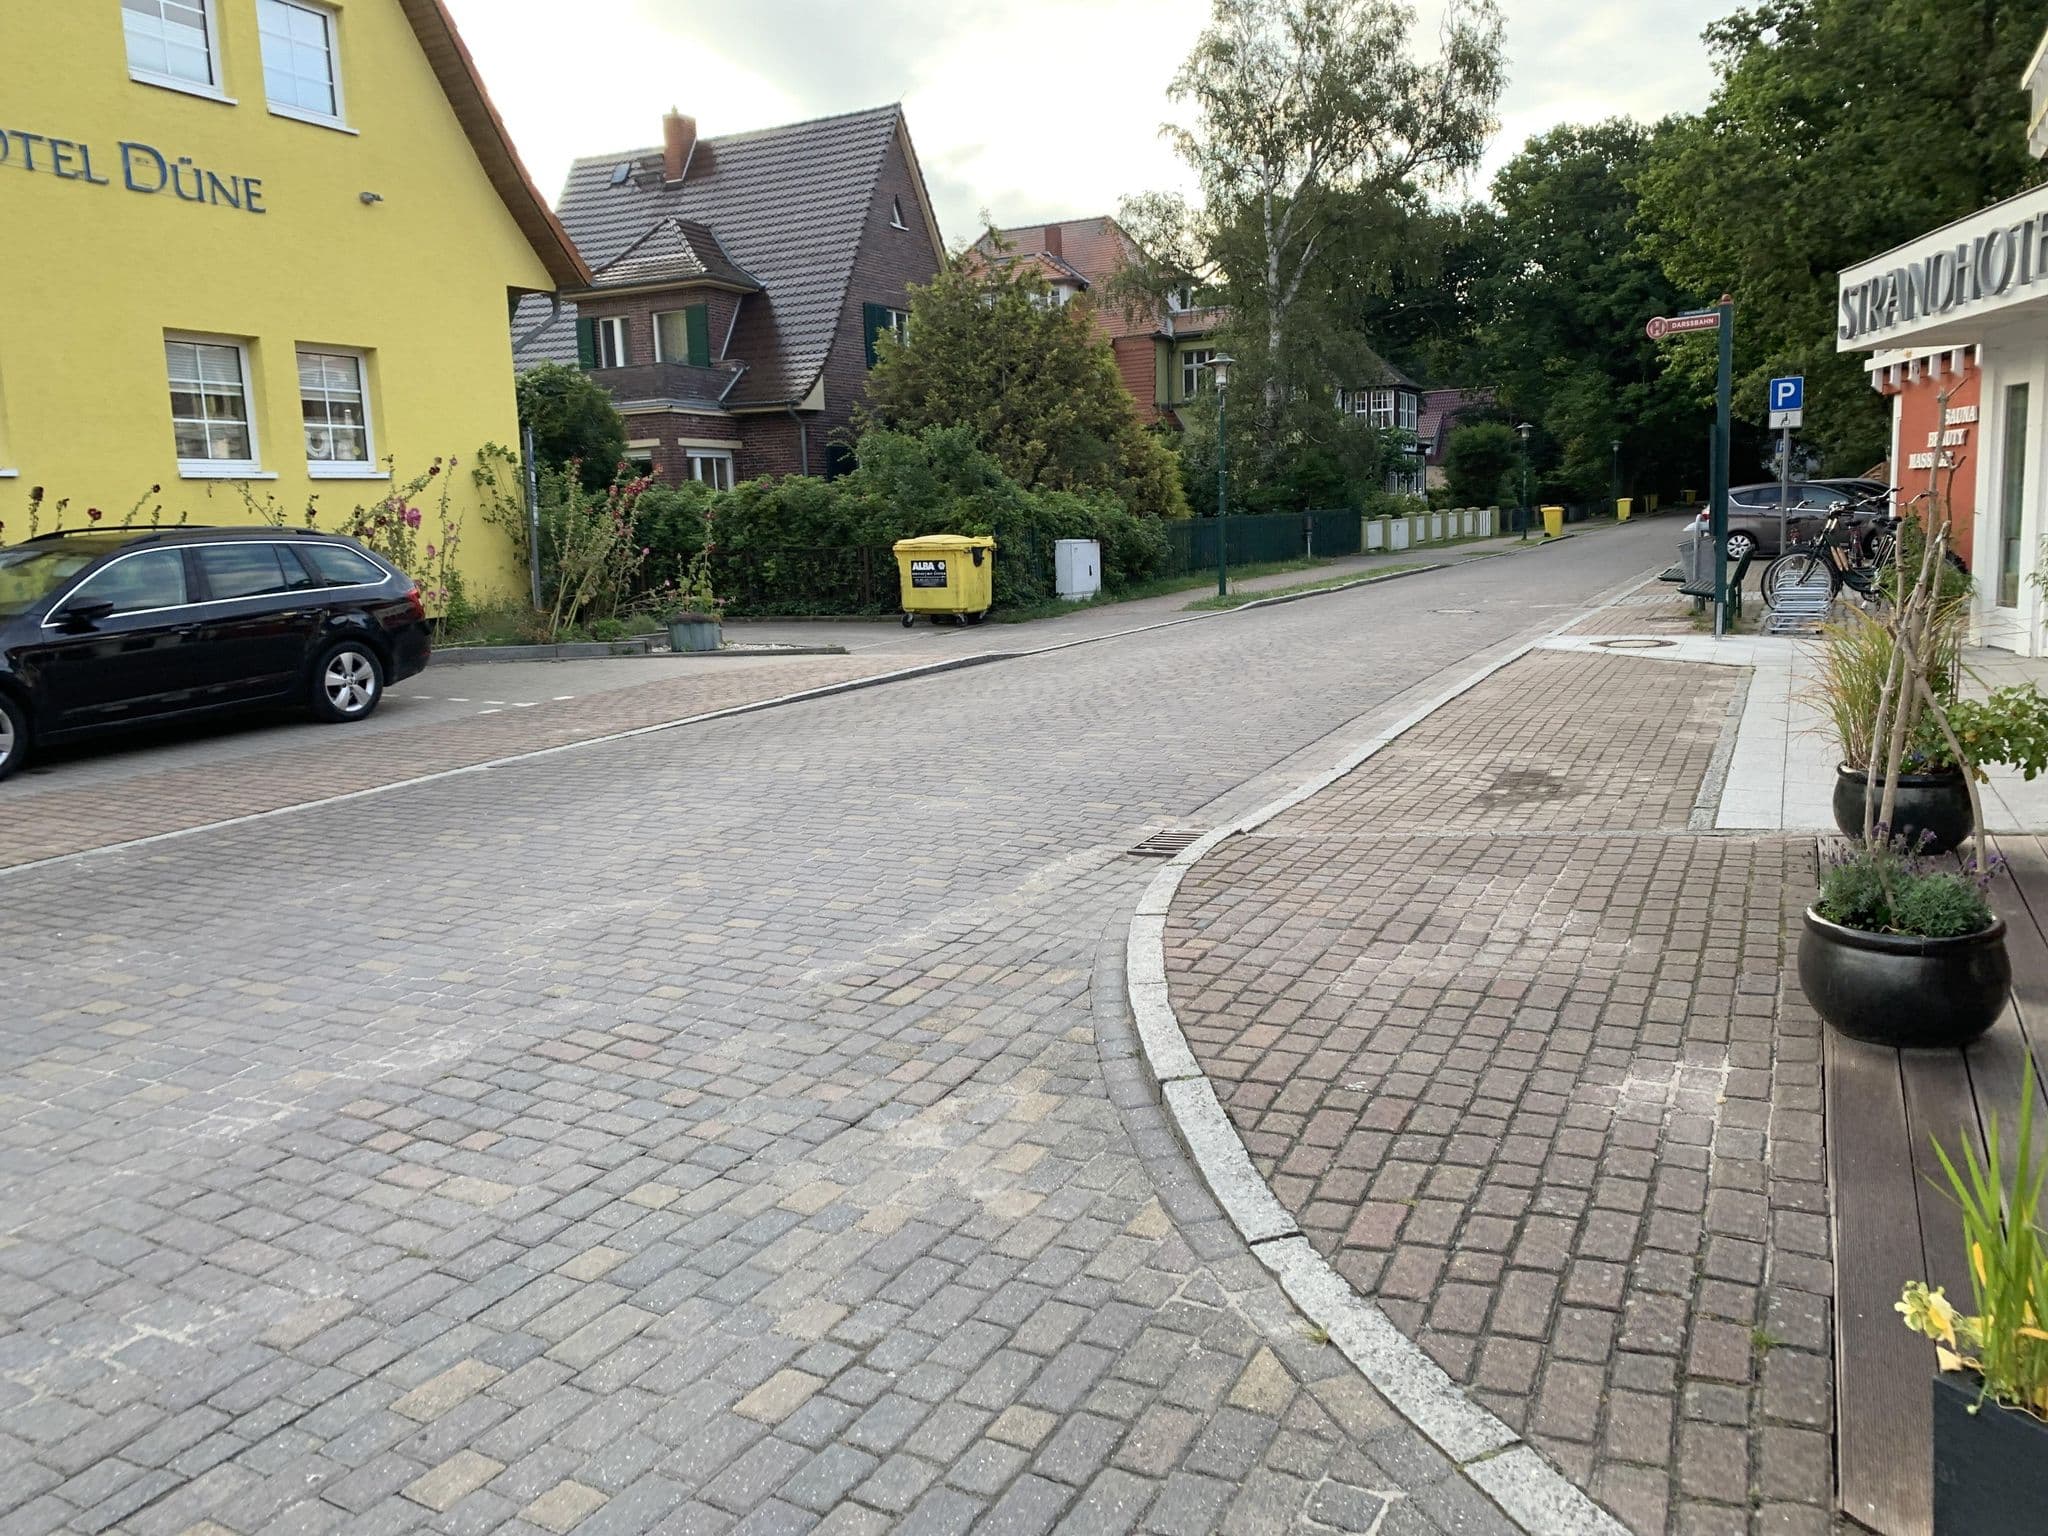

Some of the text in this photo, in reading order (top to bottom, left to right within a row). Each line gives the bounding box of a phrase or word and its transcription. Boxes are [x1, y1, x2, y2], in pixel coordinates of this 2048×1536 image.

[117, 140, 267, 214] DÜNE
[1671, 317, 1715, 329] DARSSBAHN
[1777, 382, 1796, 407] P
[1945, 405, 1978, 426] SAUNA
[1908, 451, 1954, 469] MASS
[912, 561, 935, 571] ALBA
